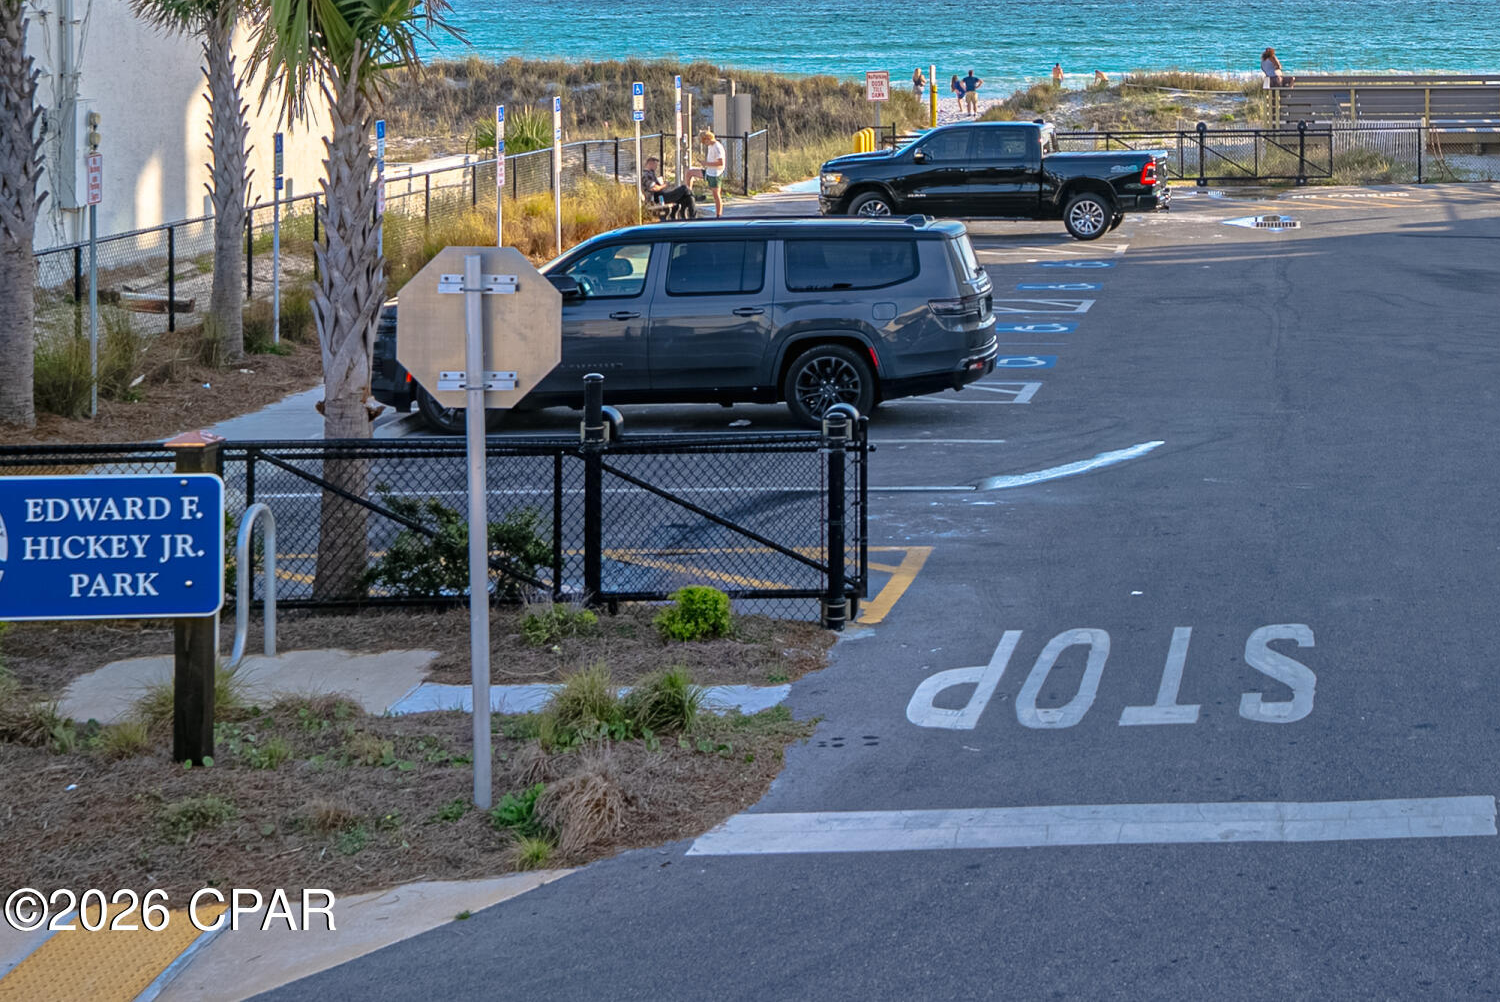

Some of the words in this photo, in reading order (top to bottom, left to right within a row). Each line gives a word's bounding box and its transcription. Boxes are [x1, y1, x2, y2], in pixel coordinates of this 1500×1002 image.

[25, 497, 171, 523] EDWARD
[180, 496, 203, 520] F.
[22, 534, 151, 560] HICKEY
[159, 533, 205, 564] JR.
[69, 572, 159, 598] PARK
[906, 623, 1316, 730] STOP
